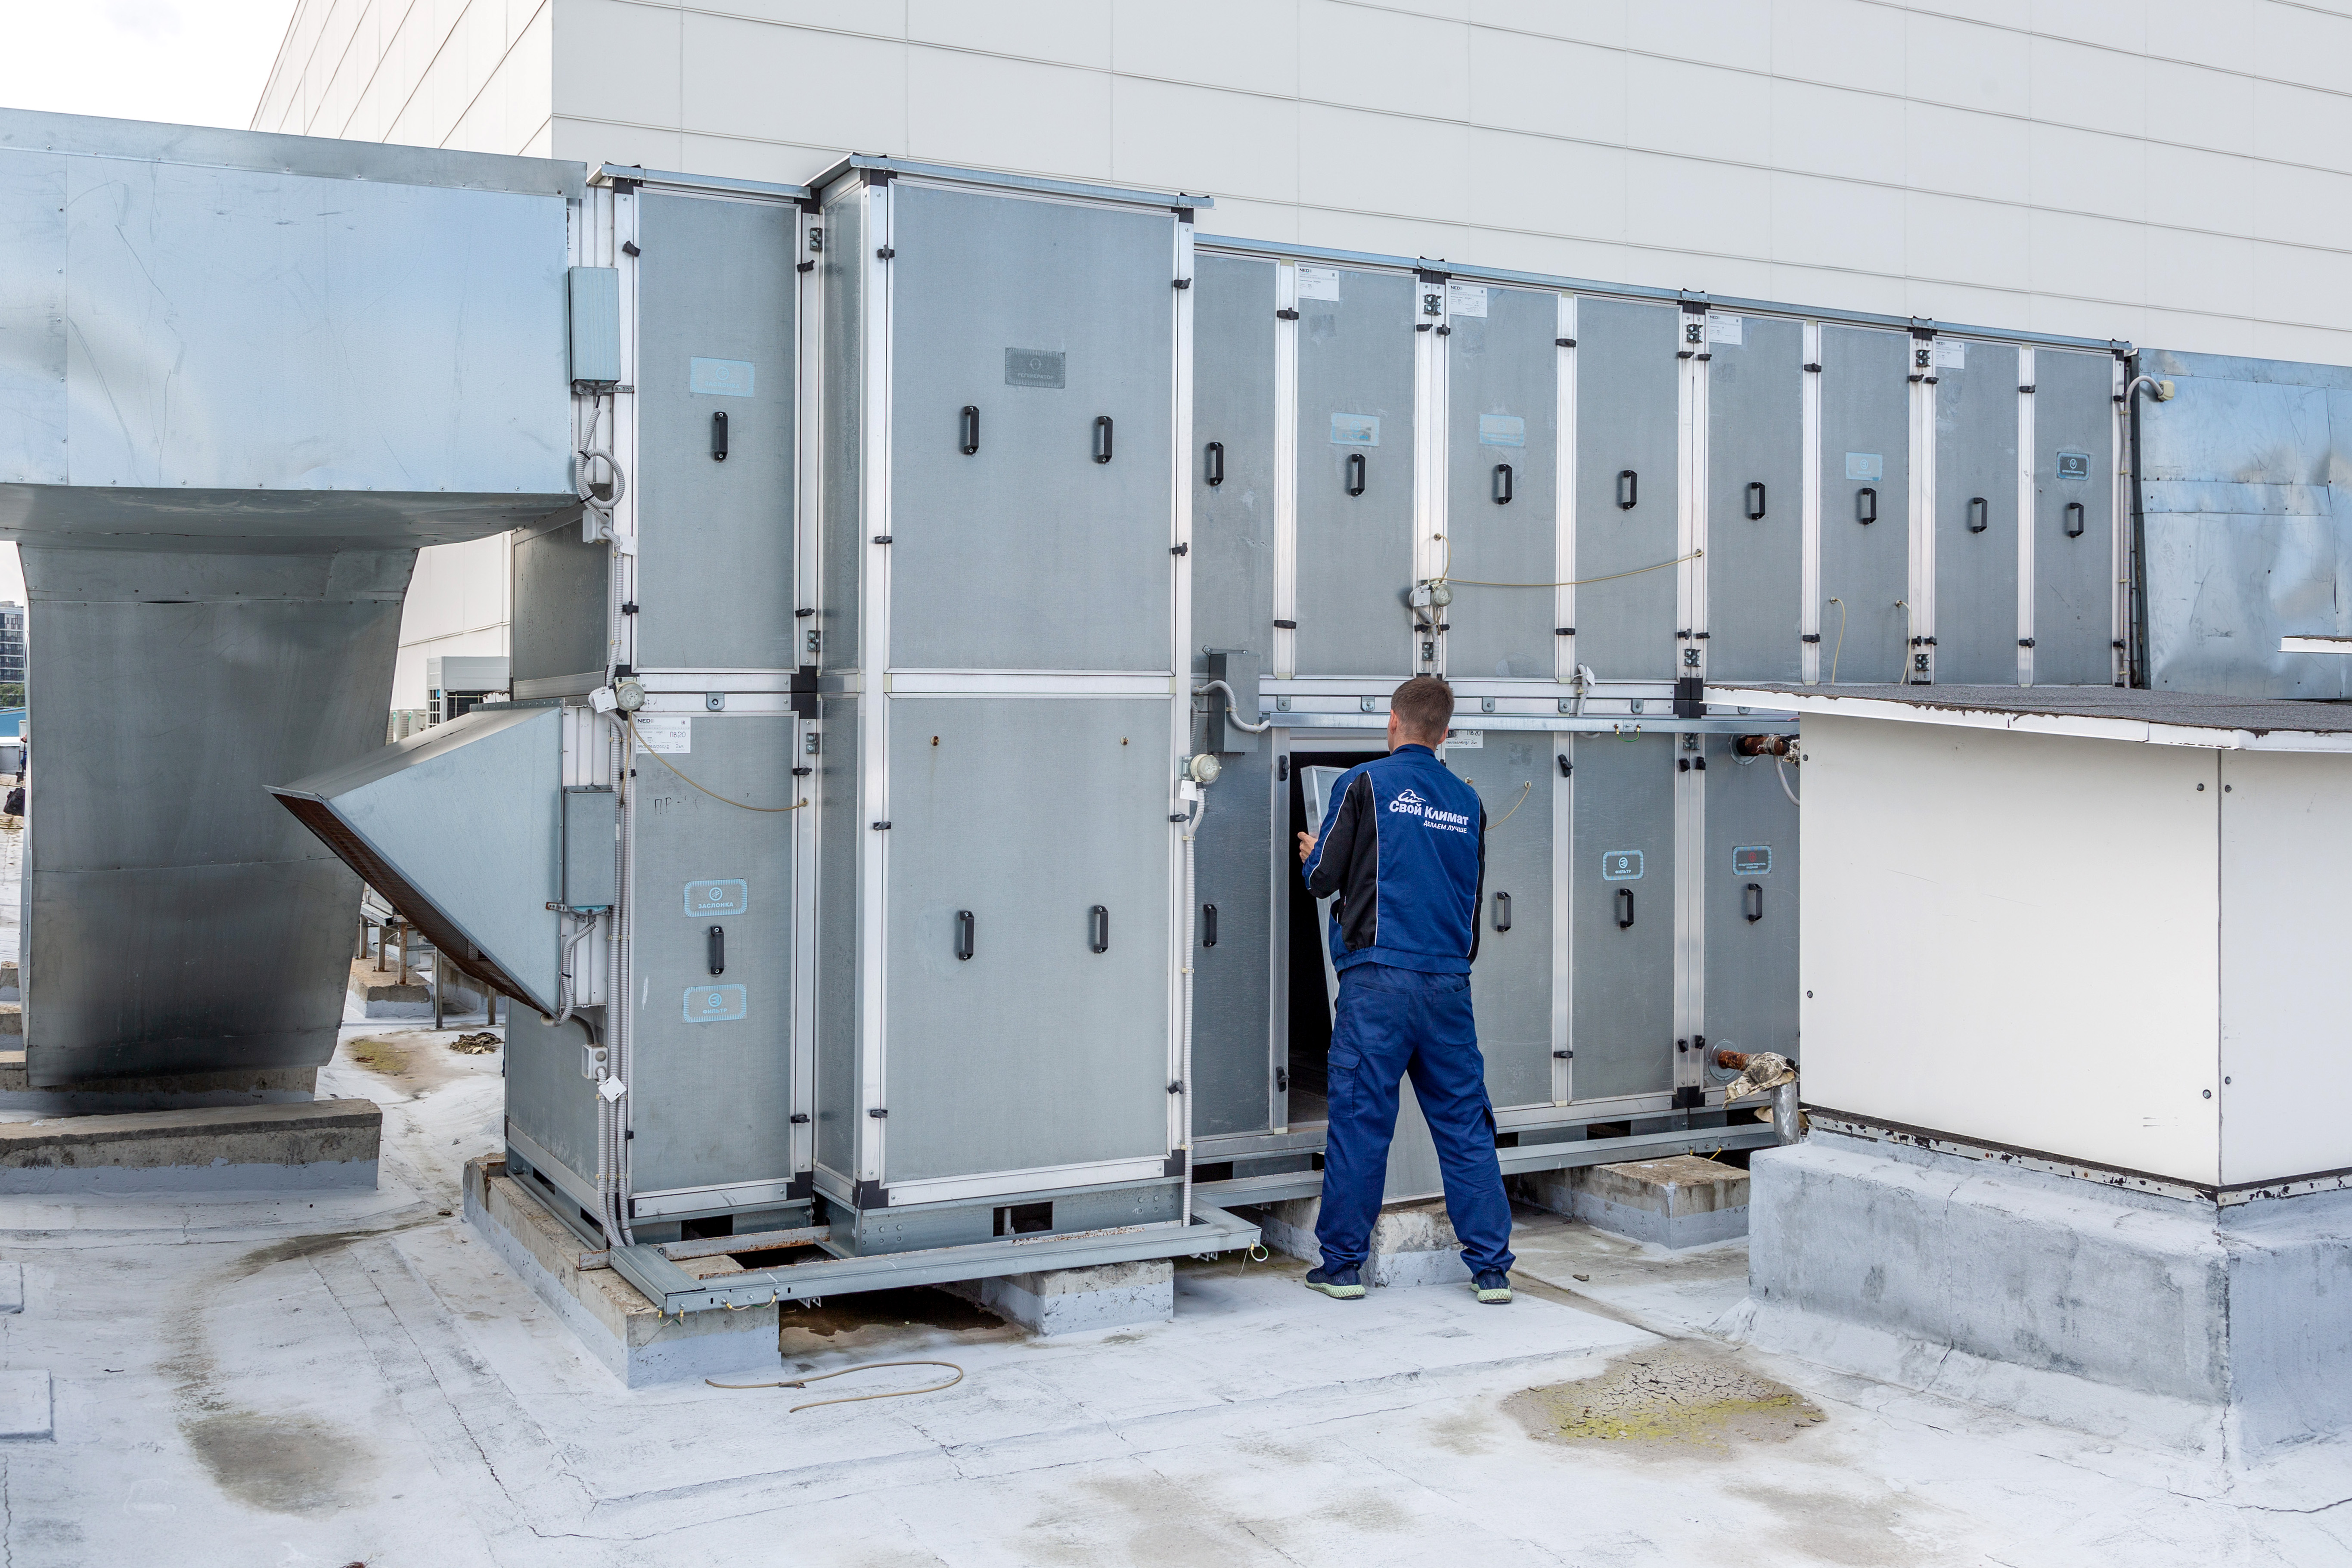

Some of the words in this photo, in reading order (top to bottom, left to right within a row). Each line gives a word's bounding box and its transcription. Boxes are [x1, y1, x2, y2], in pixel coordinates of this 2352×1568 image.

[1389, 800, 1422, 816] Свой
[1424, 805, 1469, 826] Климат
[1423, 820, 1446, 830] ДЕЛАЕМ
[1446, 825, 1468, 834] ЛУЧШЕ
